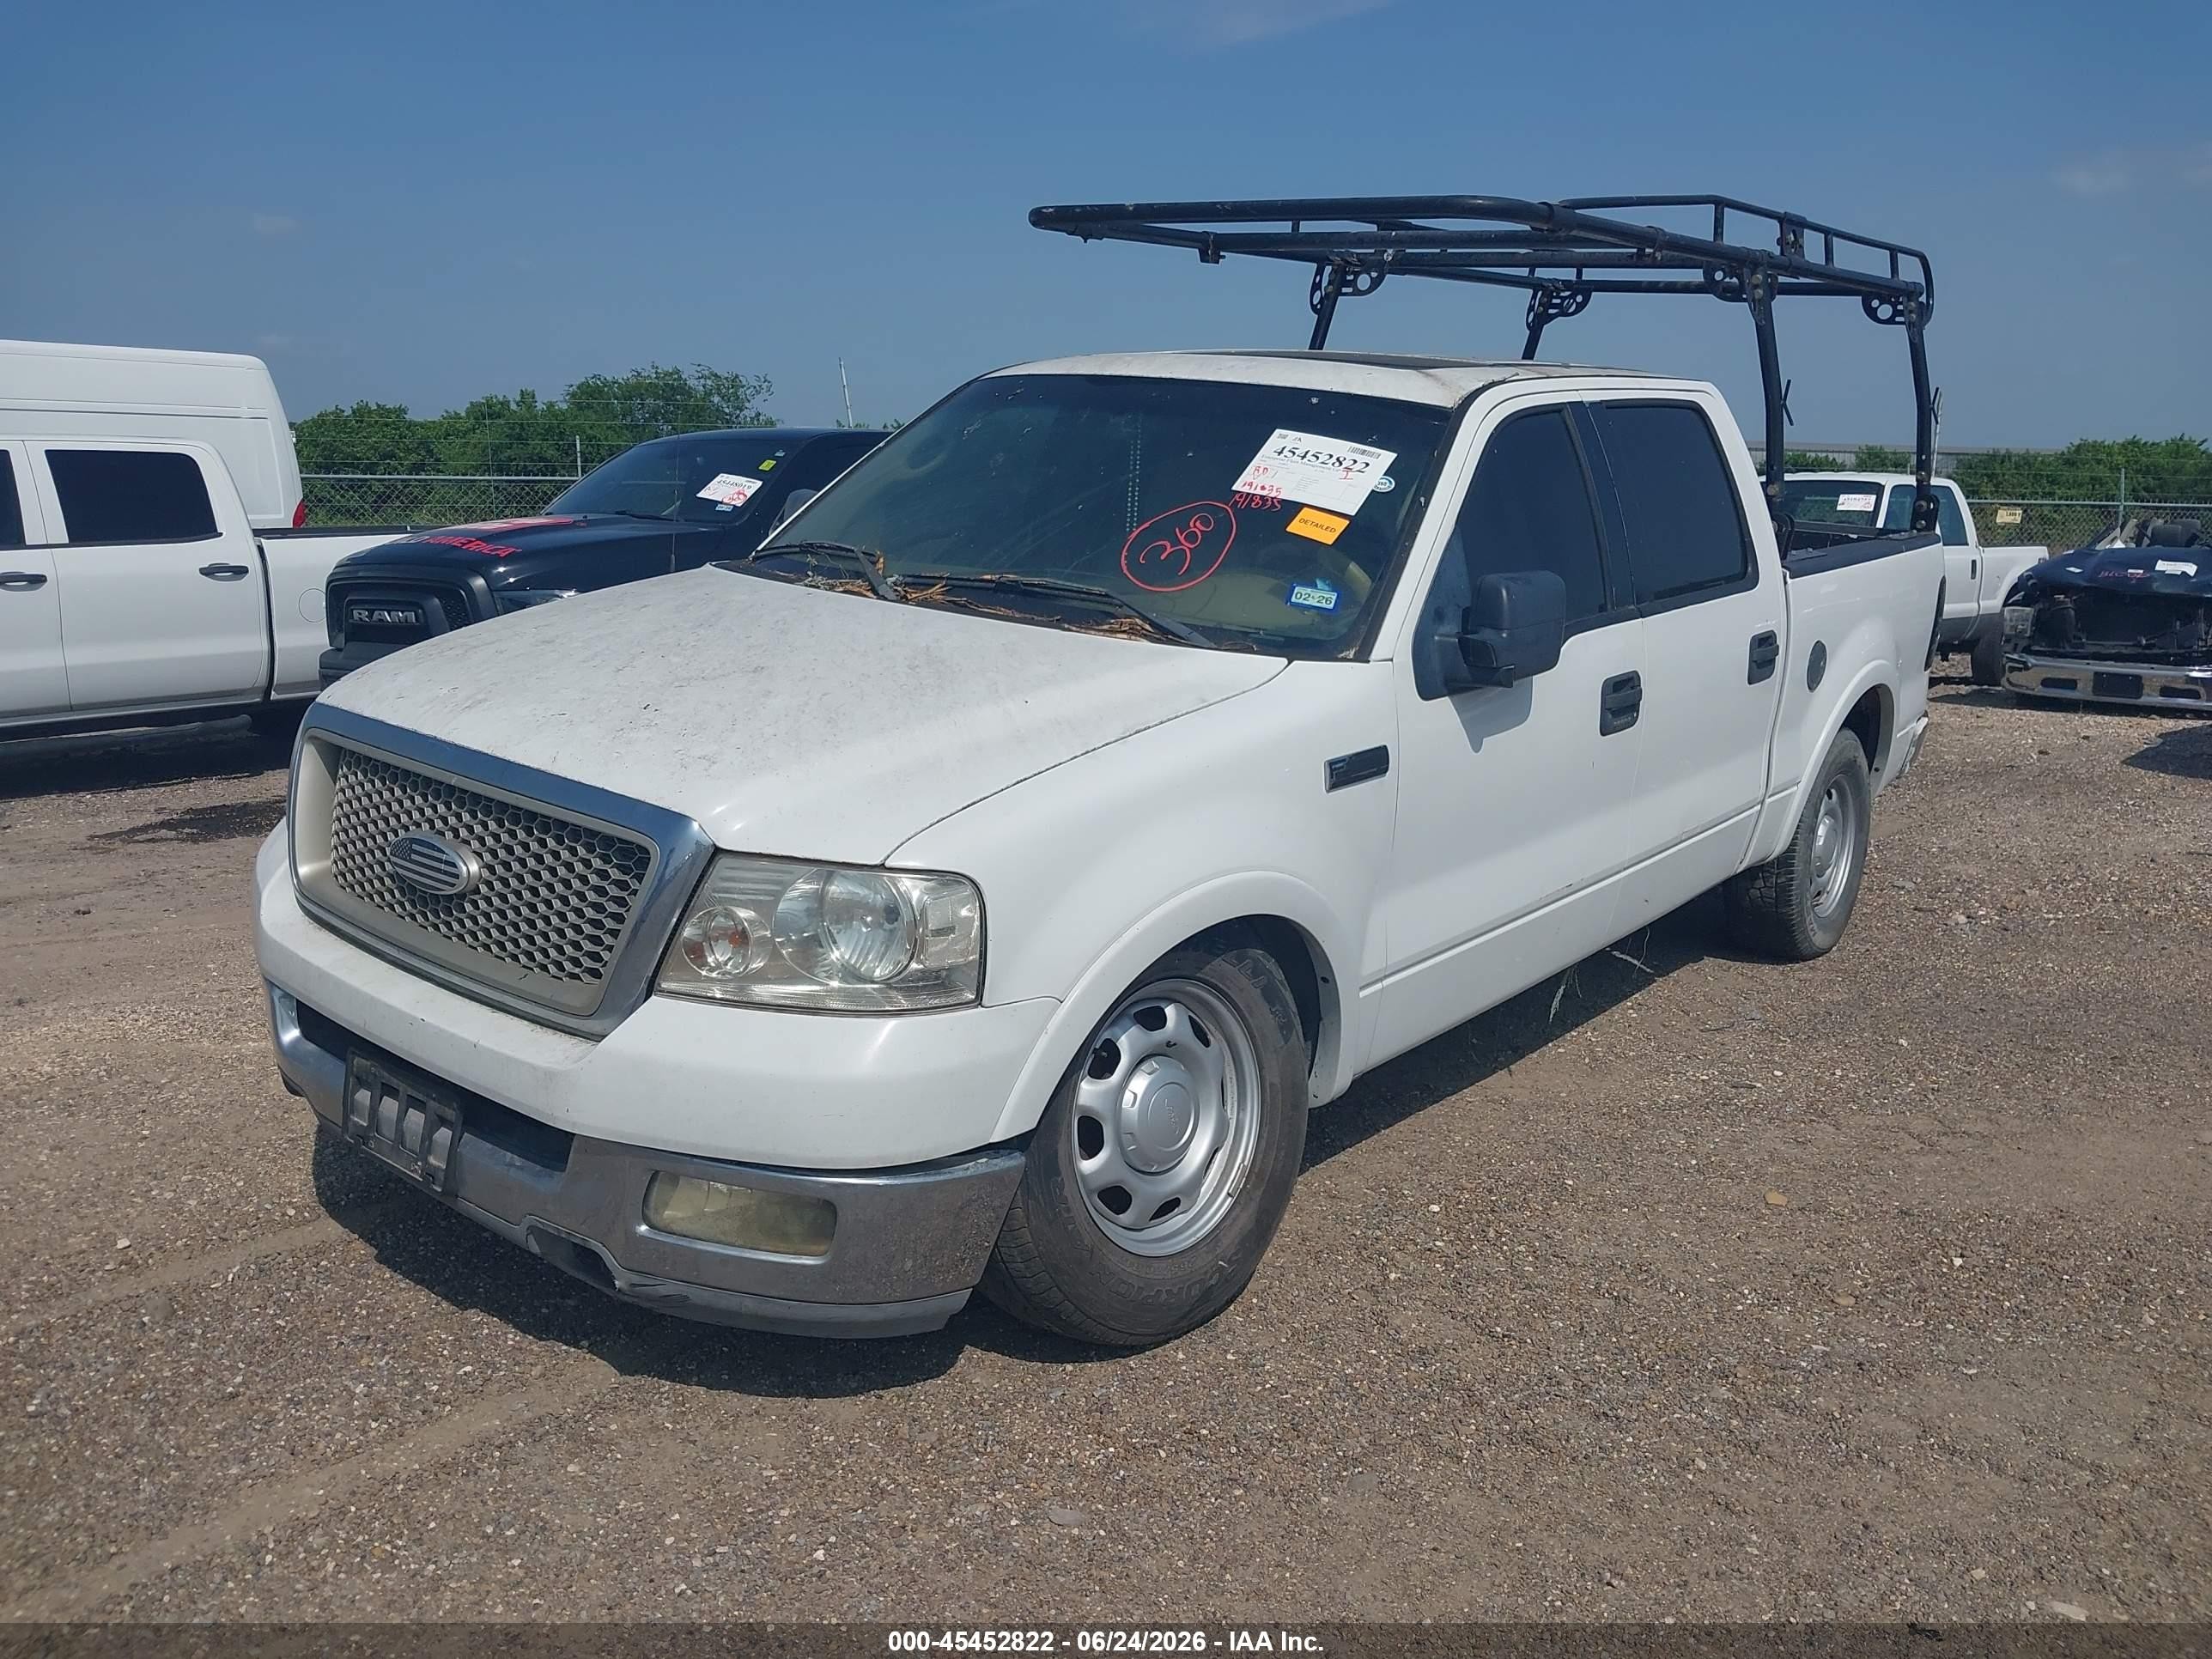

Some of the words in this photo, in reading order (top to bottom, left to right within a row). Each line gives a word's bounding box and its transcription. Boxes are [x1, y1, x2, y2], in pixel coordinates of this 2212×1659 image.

[1273, 446, 1370, 474] 45452822
[1241, 480, 1283, 496] 19135
[1229, 492, 1282, 512] 191835
[1298, 518, 1336, 533] DETAILED
[422, 535, 516, 557] AMERICA
[1139, 513, 1215, 576] 360
[352, 609, 416, 623] RAM
